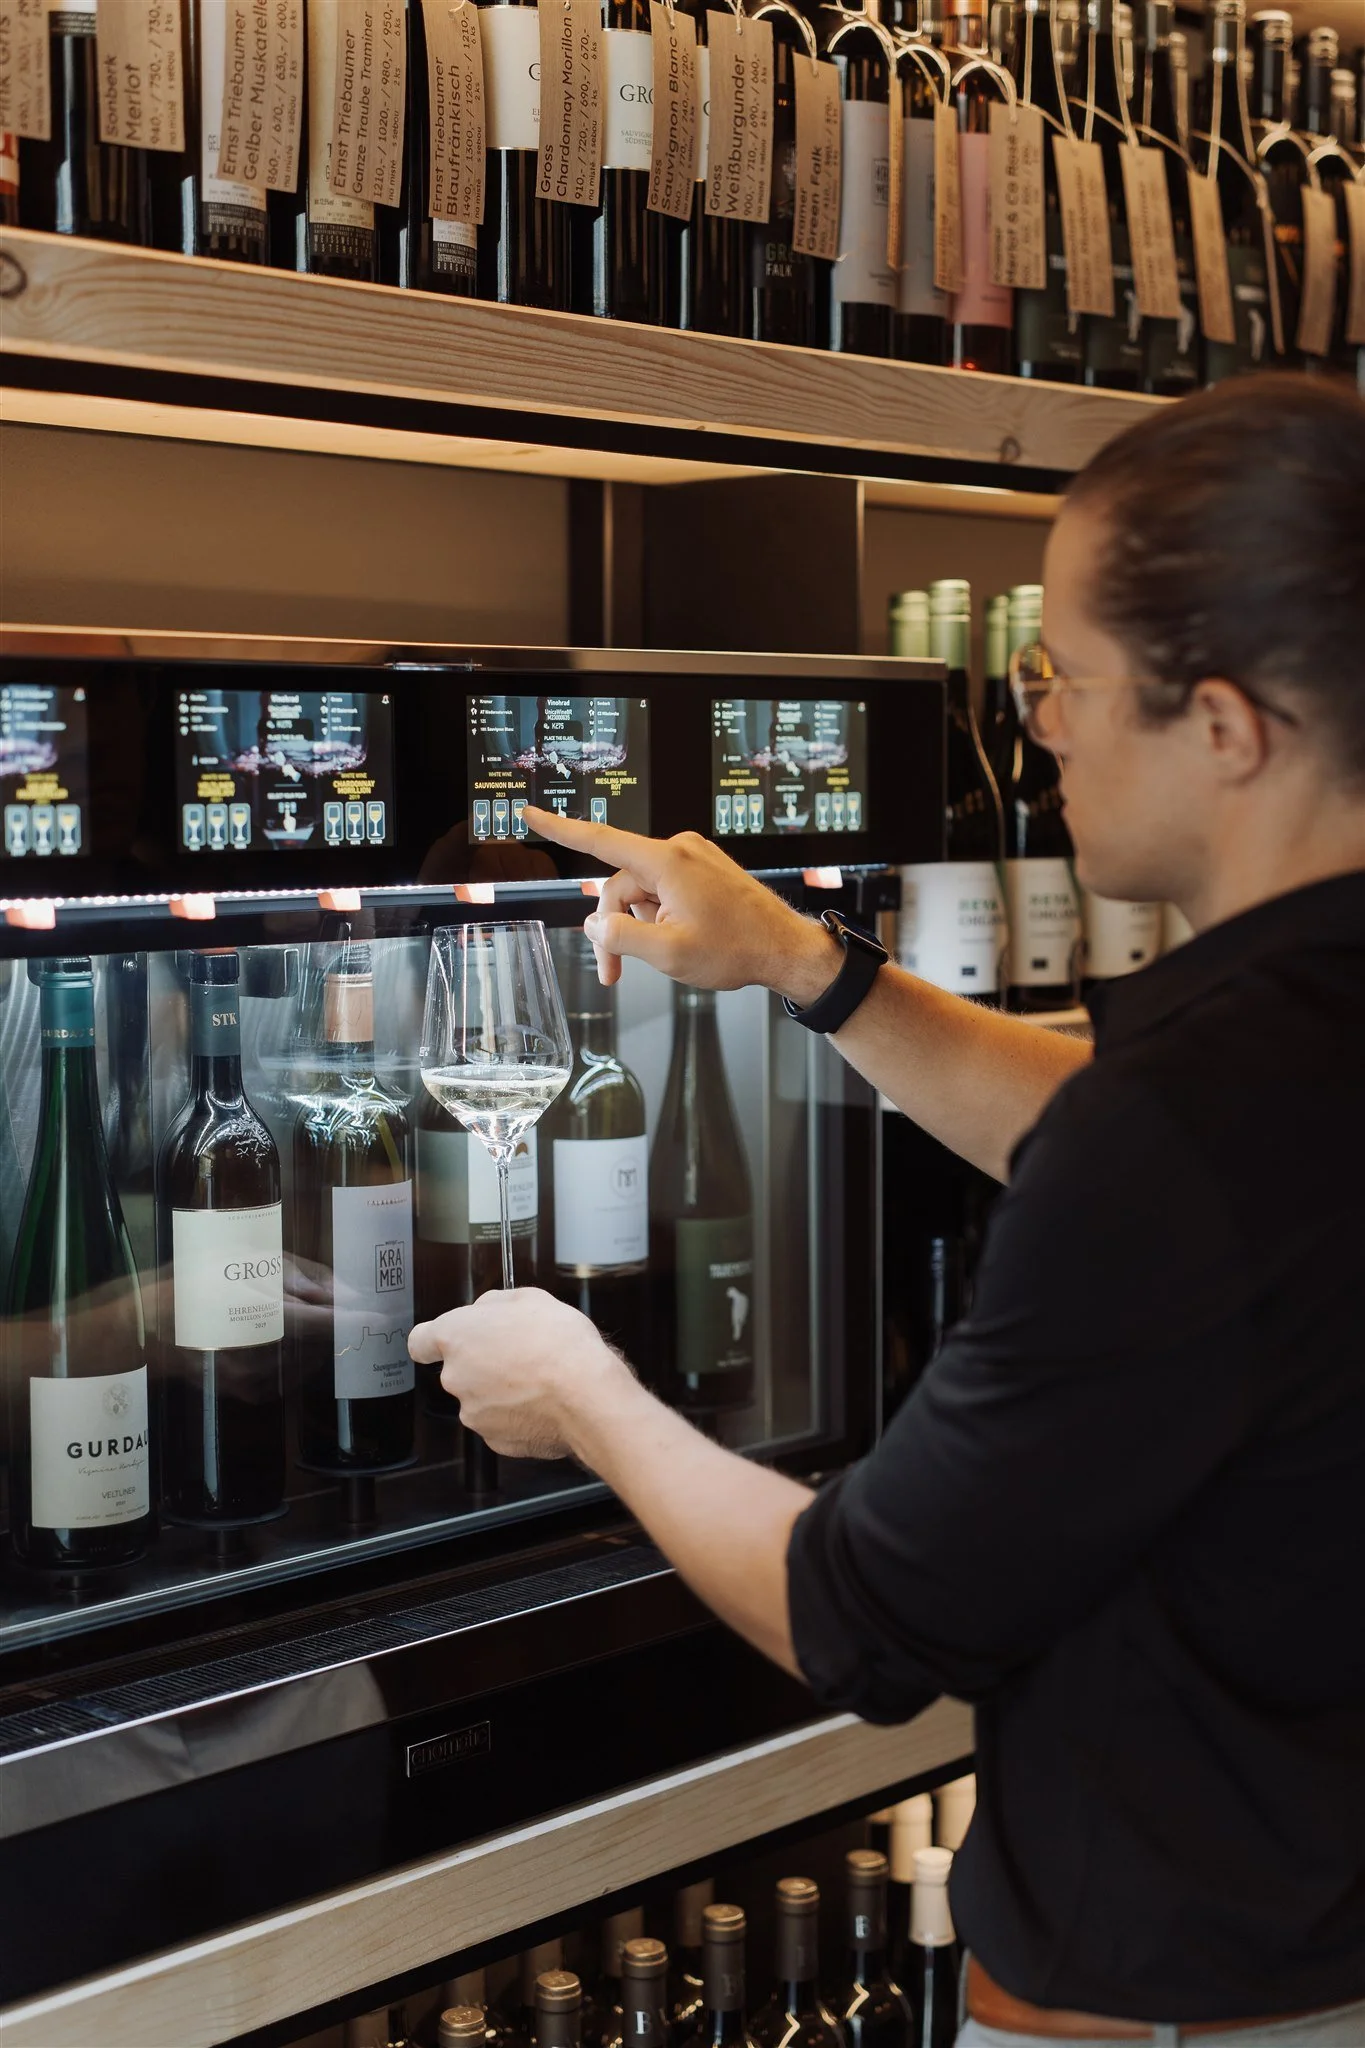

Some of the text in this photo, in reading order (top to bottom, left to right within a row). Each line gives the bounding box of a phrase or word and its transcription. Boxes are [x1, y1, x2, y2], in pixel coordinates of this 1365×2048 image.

[150, 54, 163, 88] 750,-
[275, 45, 288, 80] 630,-
[682, 48, 690, 76] 720,-
[104, 54, 119, 137] Sonberk
[124, 64, 142, 141] Merlot
[223, 10, 247, 175] Ernst Triebaumer
[271, 98, 285, 132] 670,-
[333, 29, 357, 188] Ernst Triebaumer
[352, 11, 374, 194] Ganze Traube Traminer
[373, 2, 394, 198] 1210,- 1020,- 980,- 950,-
[461, 11, 476, 218] 1490,- 1300,- 1260,- 1210,-
[556, 17, 576, 197] Chardonnay Morillon
[576, 29, 591, 199] 910,- 720,- 690,- 670,-
[682, 92, 690, 122] 740,-
[244, 110, 264, 180] Gelber
[433, 57, 446, 212] Ernst Triebaumer
[447, 65, 462, 215] Blaufränkisch
[662, 37, 680, 210] Sauvignon Blanc
[725, 54, 747, 214] Weißburgunder
[744, 53, 761, 216] 900,- 710,- 690,- 660,-
[268, 148, 281, 184] 860,-
[541, 144, 554, 192] Gross
[679, 138, 688, 167] 770,-
[651, 159, 663, 205] Gross
[709, 165, 723, 211] Gross
[807, 145, 823, 251] Green Falk
[796, 187, 808, 248] Kramer
[765, 263, 792, 278] FALK
[333, 780, 375, 788] CHARDONNAY
[212, 1012, 237, 1027] STK
[224, 1256, 281, 1281] GROSS
[380, 1248, 402, 1268] KRA
[380, 1267, 402, 1287] MER
[230, 1313, 261, 1322] MORILLON
[102, 1487, 136, 1499] VELTLINER
